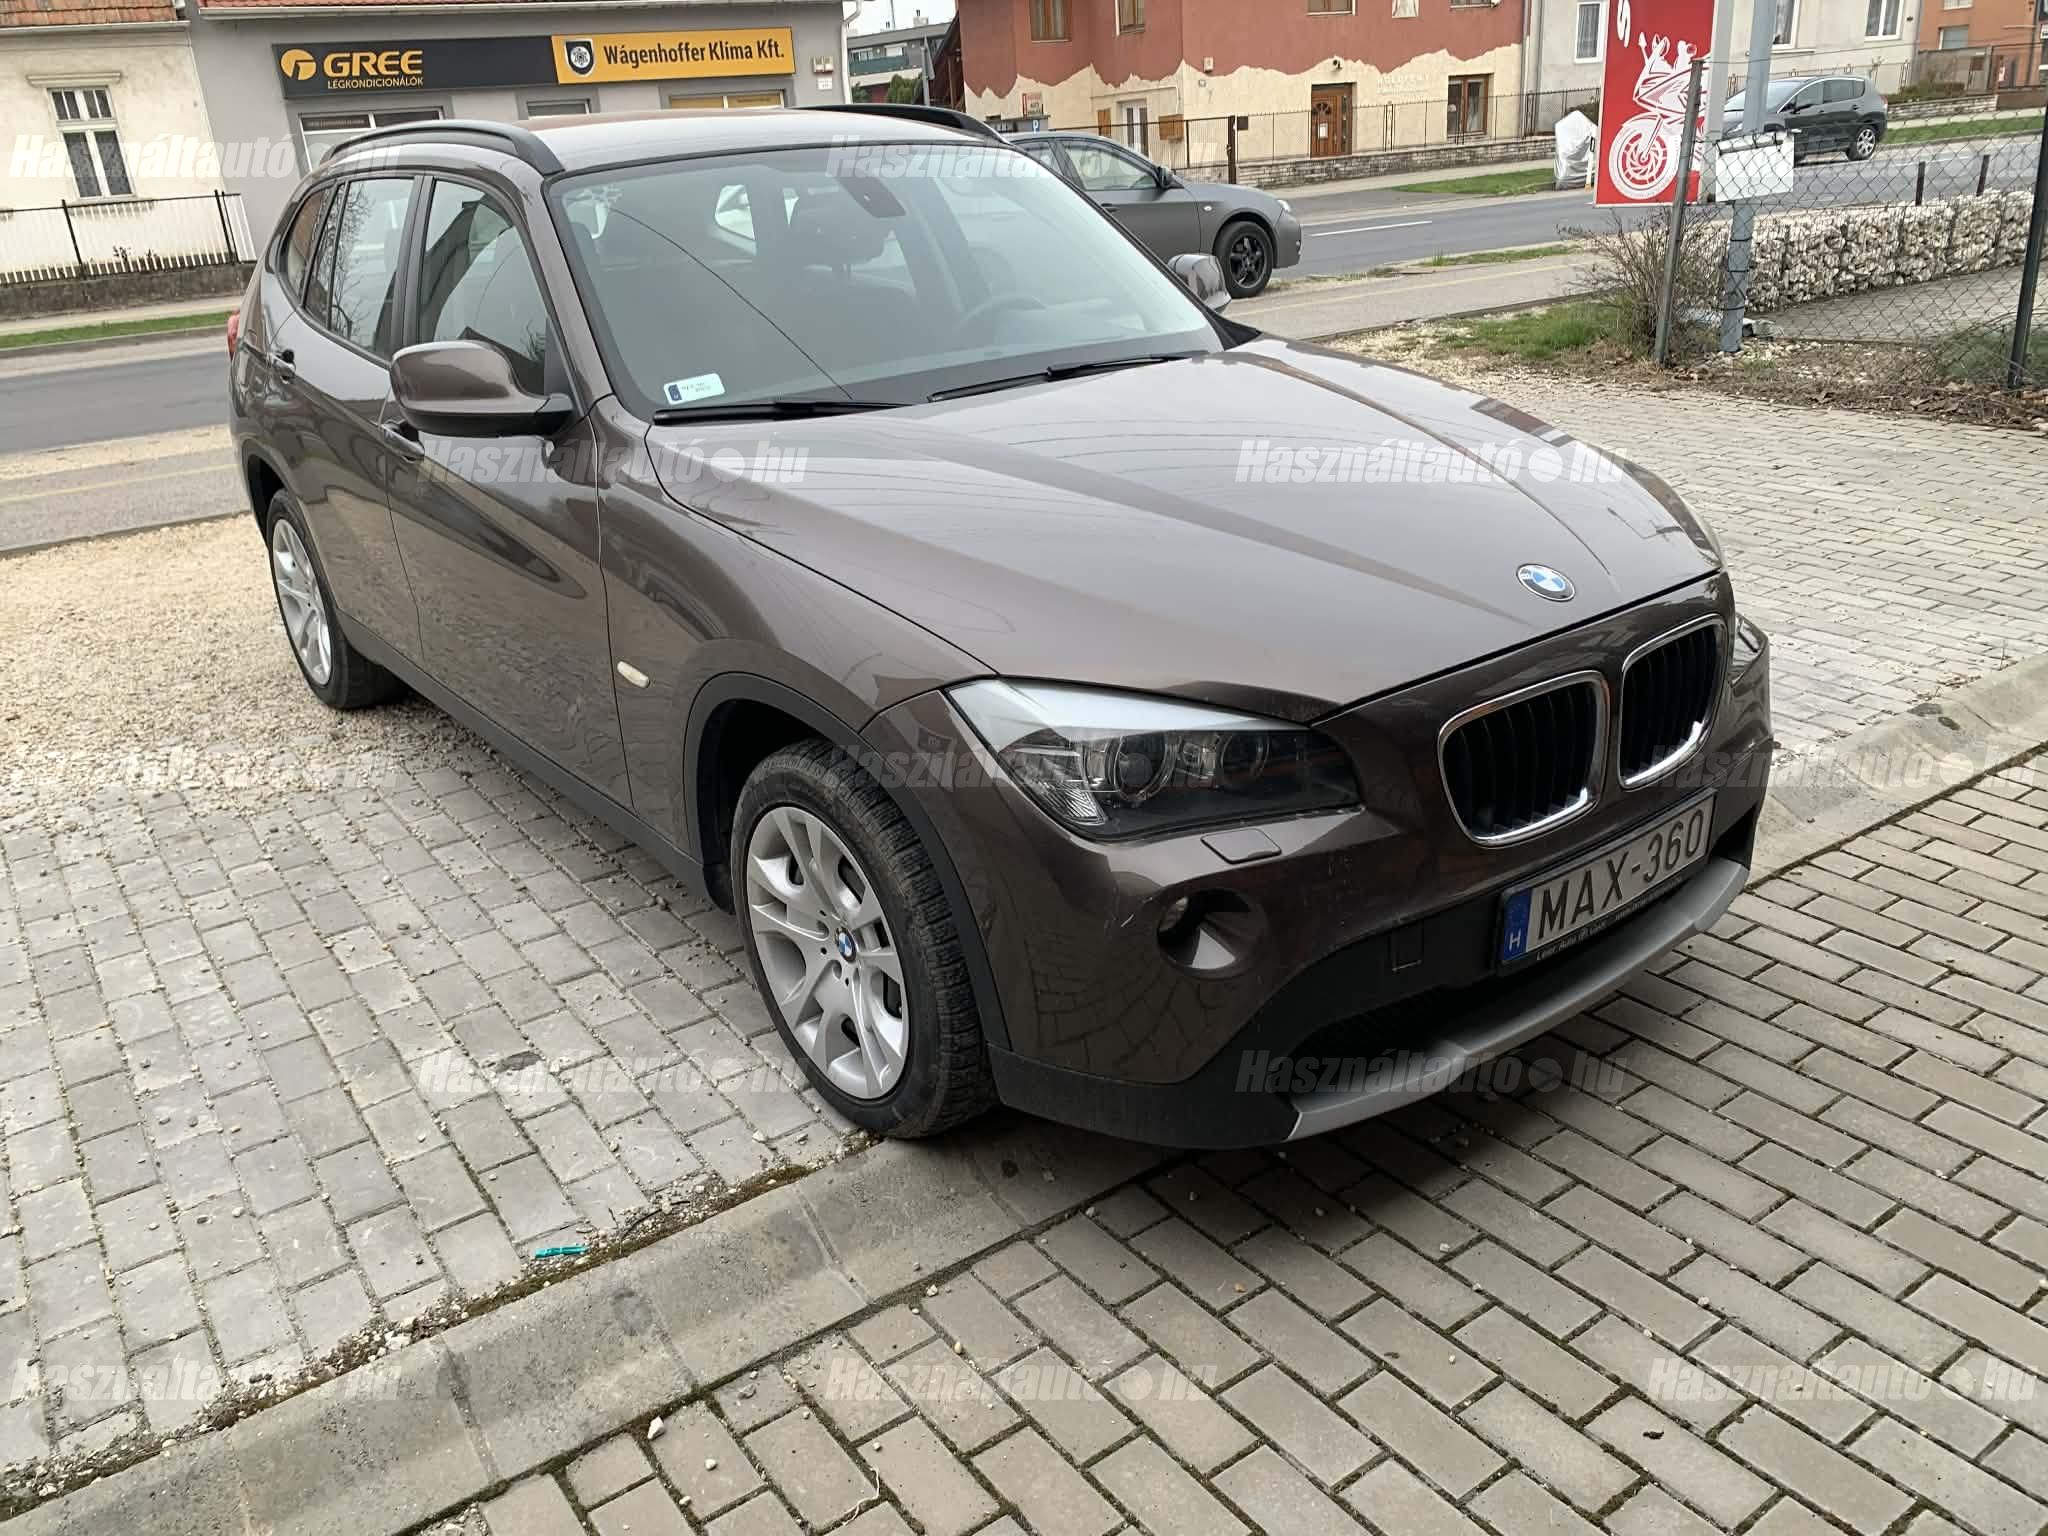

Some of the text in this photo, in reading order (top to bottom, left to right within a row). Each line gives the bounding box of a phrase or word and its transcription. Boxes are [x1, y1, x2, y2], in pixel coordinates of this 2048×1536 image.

[323, 50, 423, 78] GREE
[603, 42, 706, 69] Wágenhoffer
[757, 38, 785, 58] Kft.
[1538, 809, 1704, 940] MAX-360
[1508, 930, 1522, 951] H
